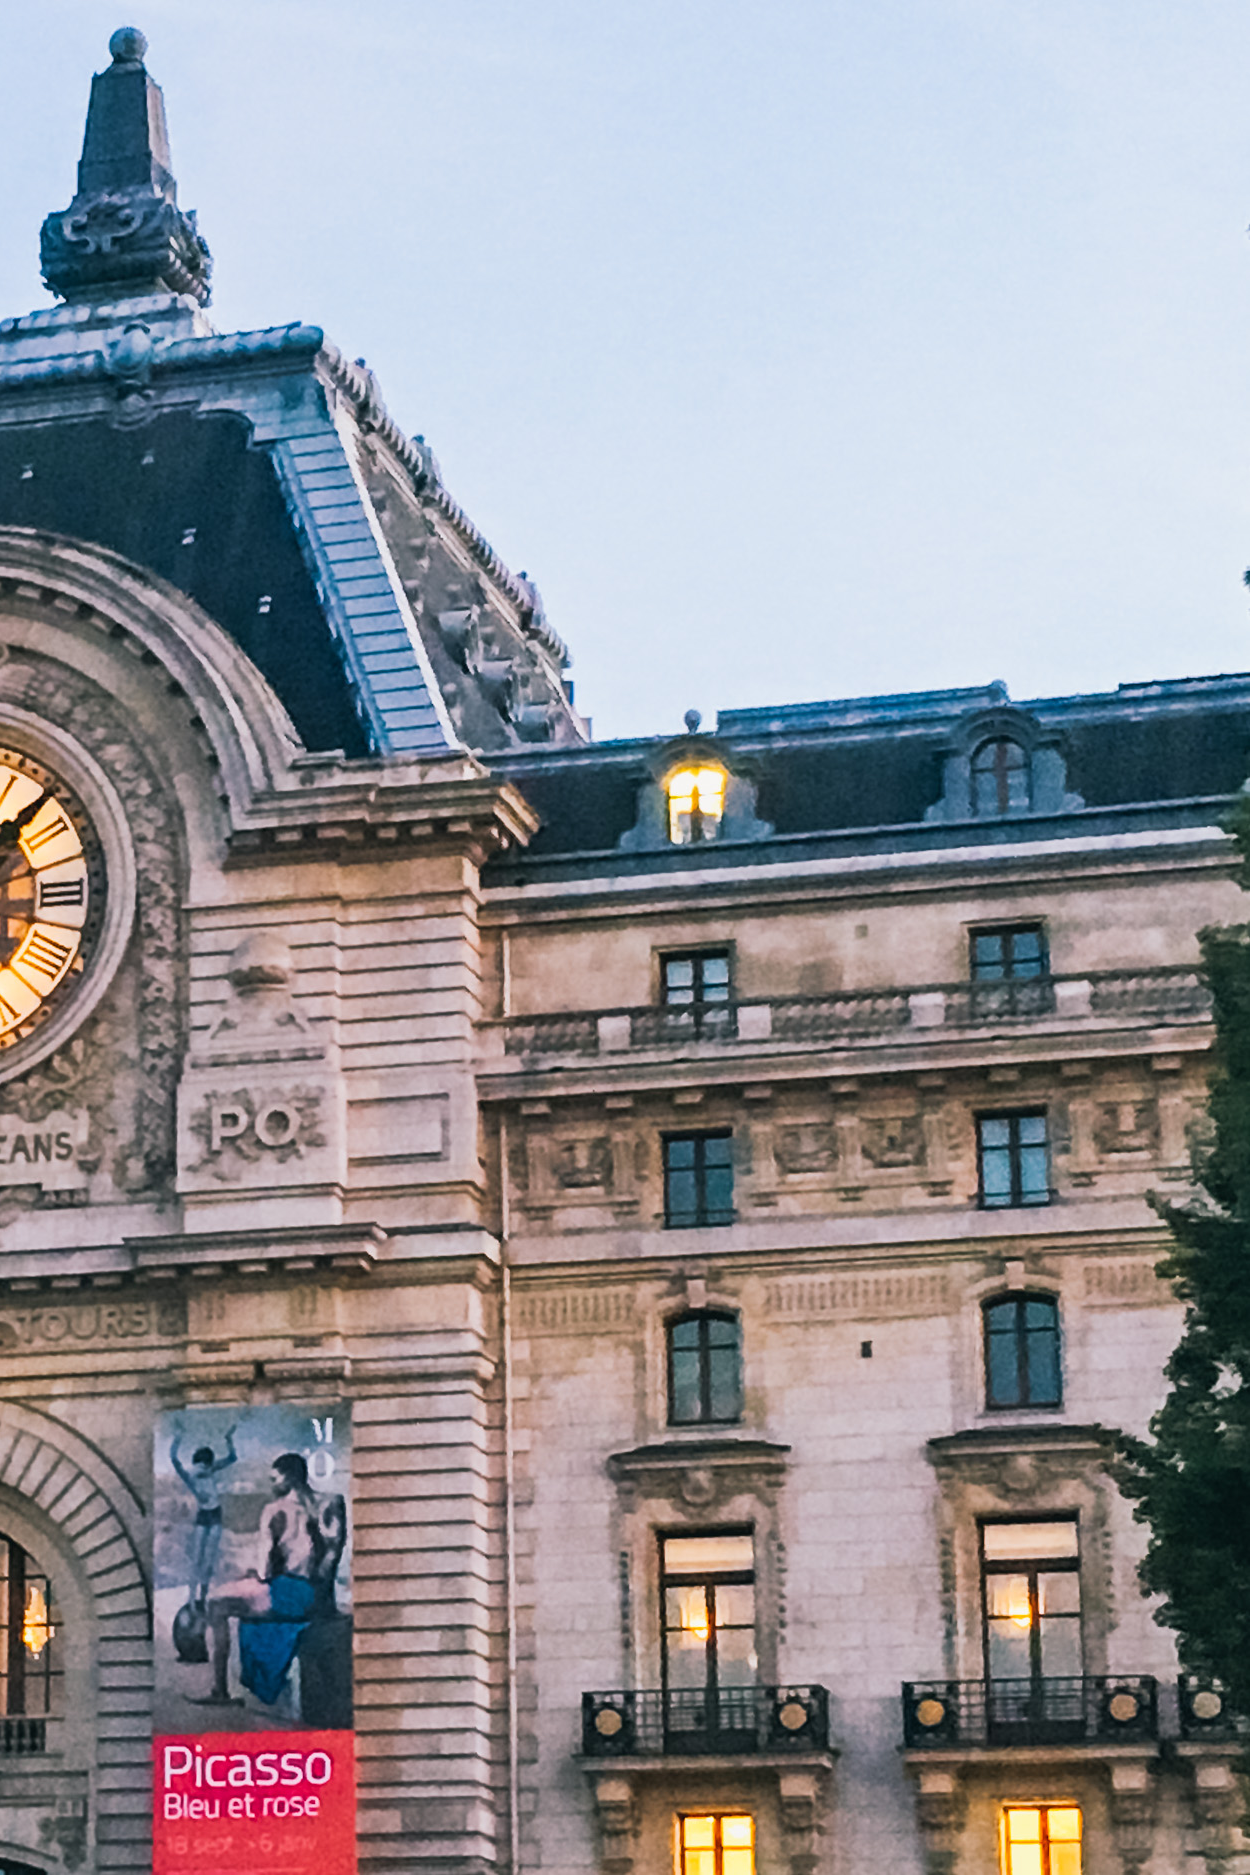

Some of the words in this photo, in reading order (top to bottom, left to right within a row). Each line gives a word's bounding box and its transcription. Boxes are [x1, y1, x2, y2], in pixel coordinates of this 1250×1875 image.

[25, 816, 69, 854] II
[39, 878, 84, 908] III
[211, 1103, 301, 1150] PO
[15, 1304, 149, 1344] TOURS
[163, 1744, 332, 1789] Picasso
[163, 1792, 220, 1820] Bleu
[227, 1792, 256, 1819] et
[262, 1794, 321, 1818] rose
